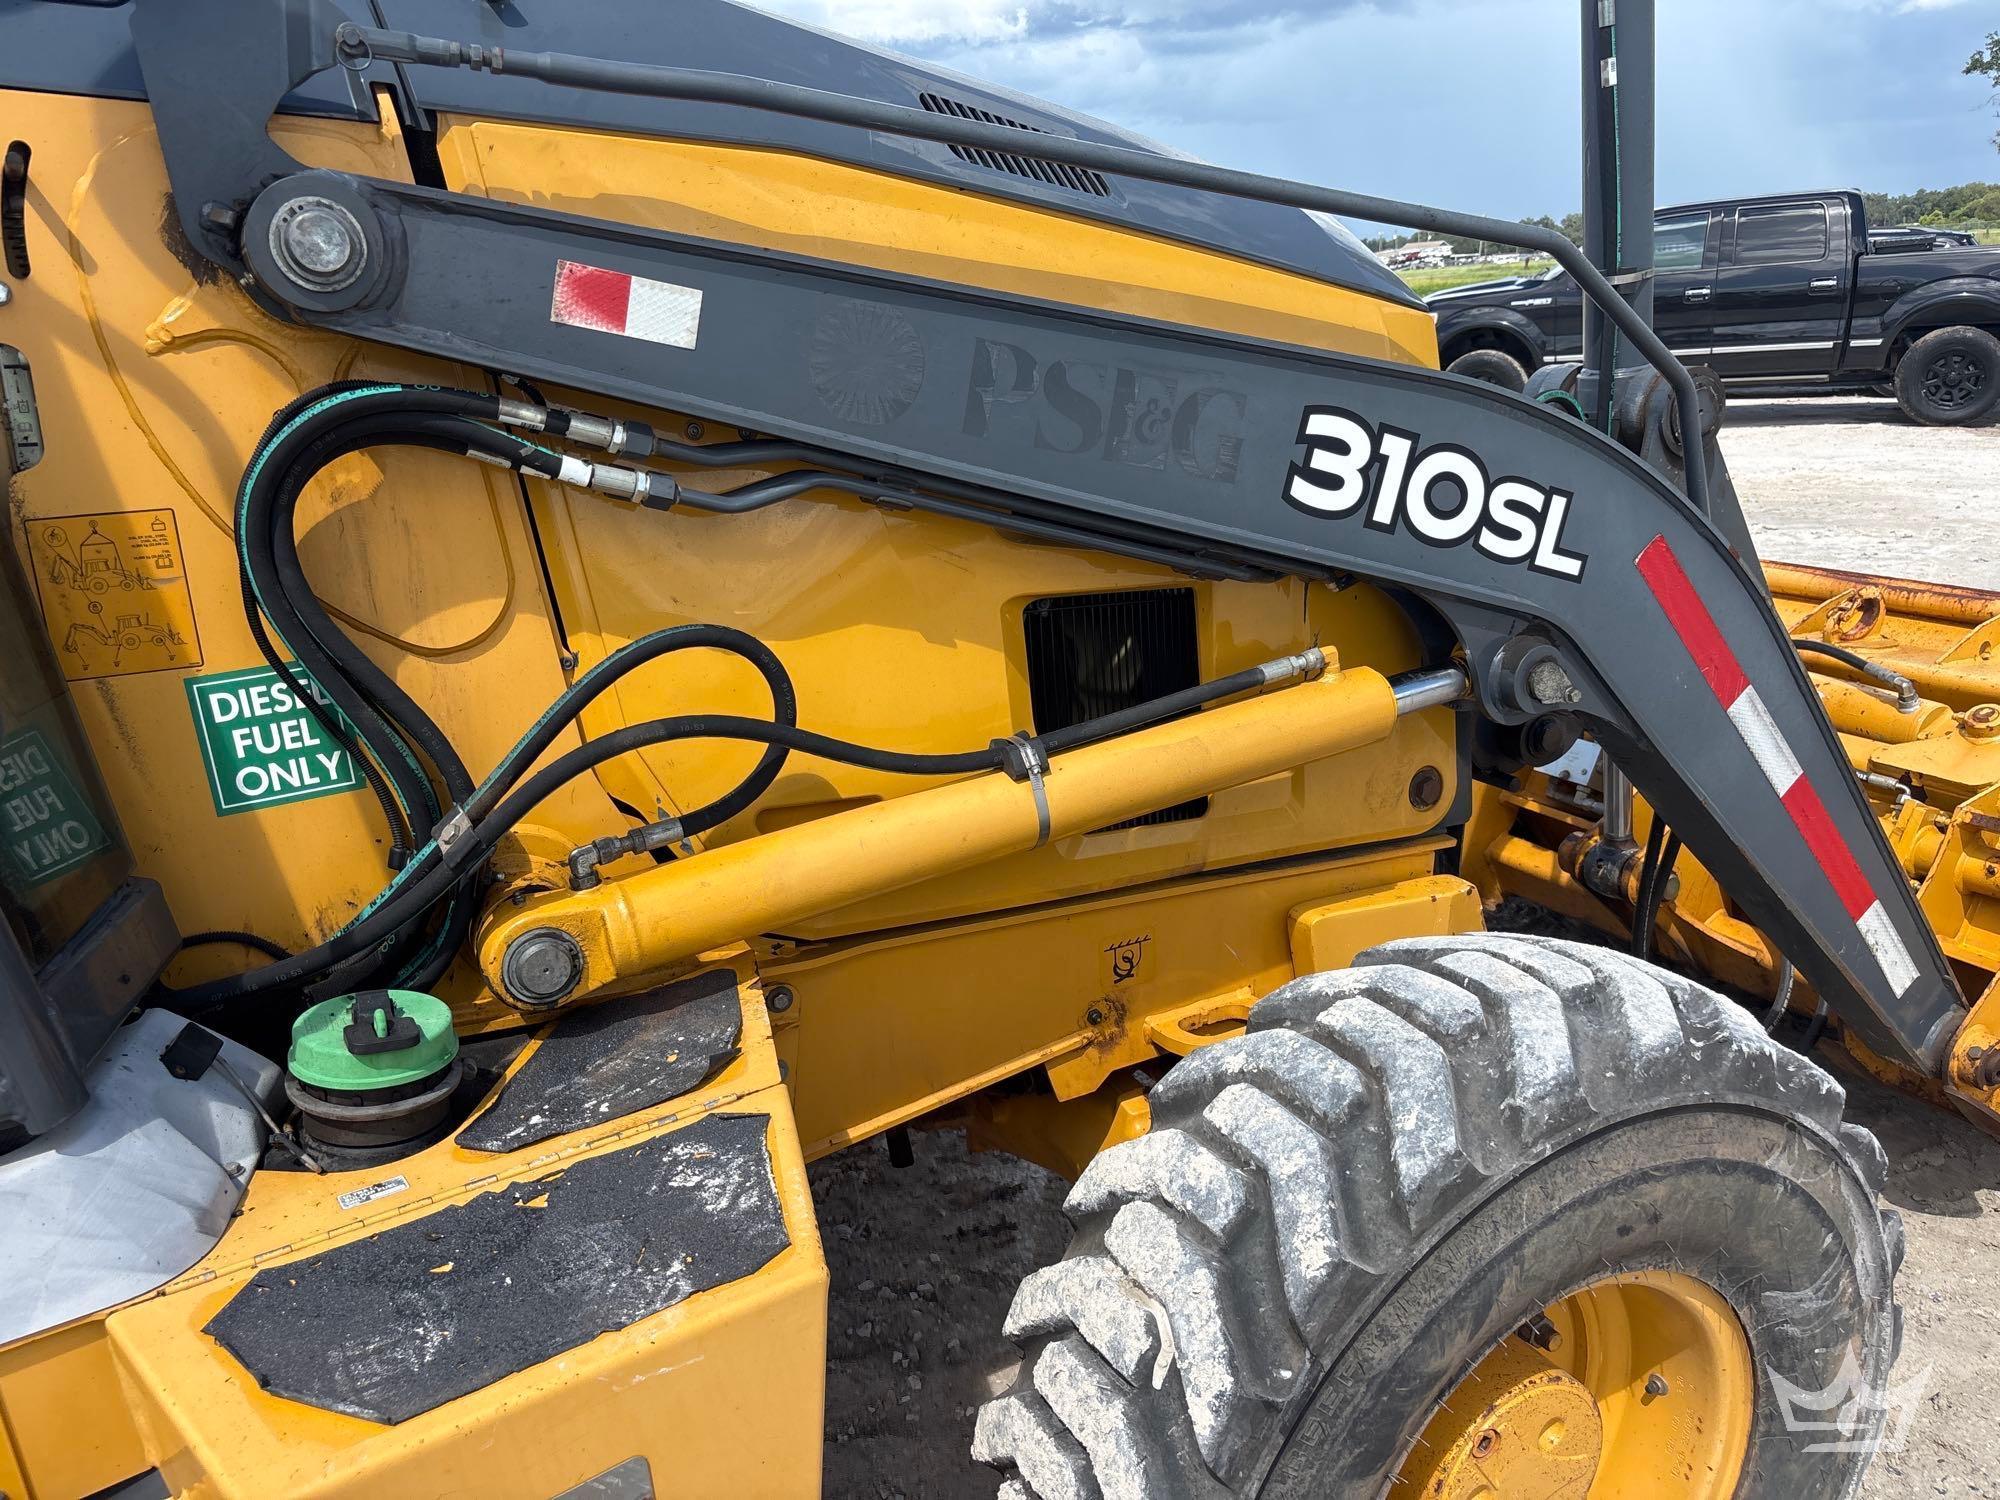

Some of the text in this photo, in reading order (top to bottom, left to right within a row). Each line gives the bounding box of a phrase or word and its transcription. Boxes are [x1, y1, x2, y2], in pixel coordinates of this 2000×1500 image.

[1283, 407, 1587, 582] 310SL
[232, 717, 320, 759] FUEL
[235, 750, 342, 796] ONLY
